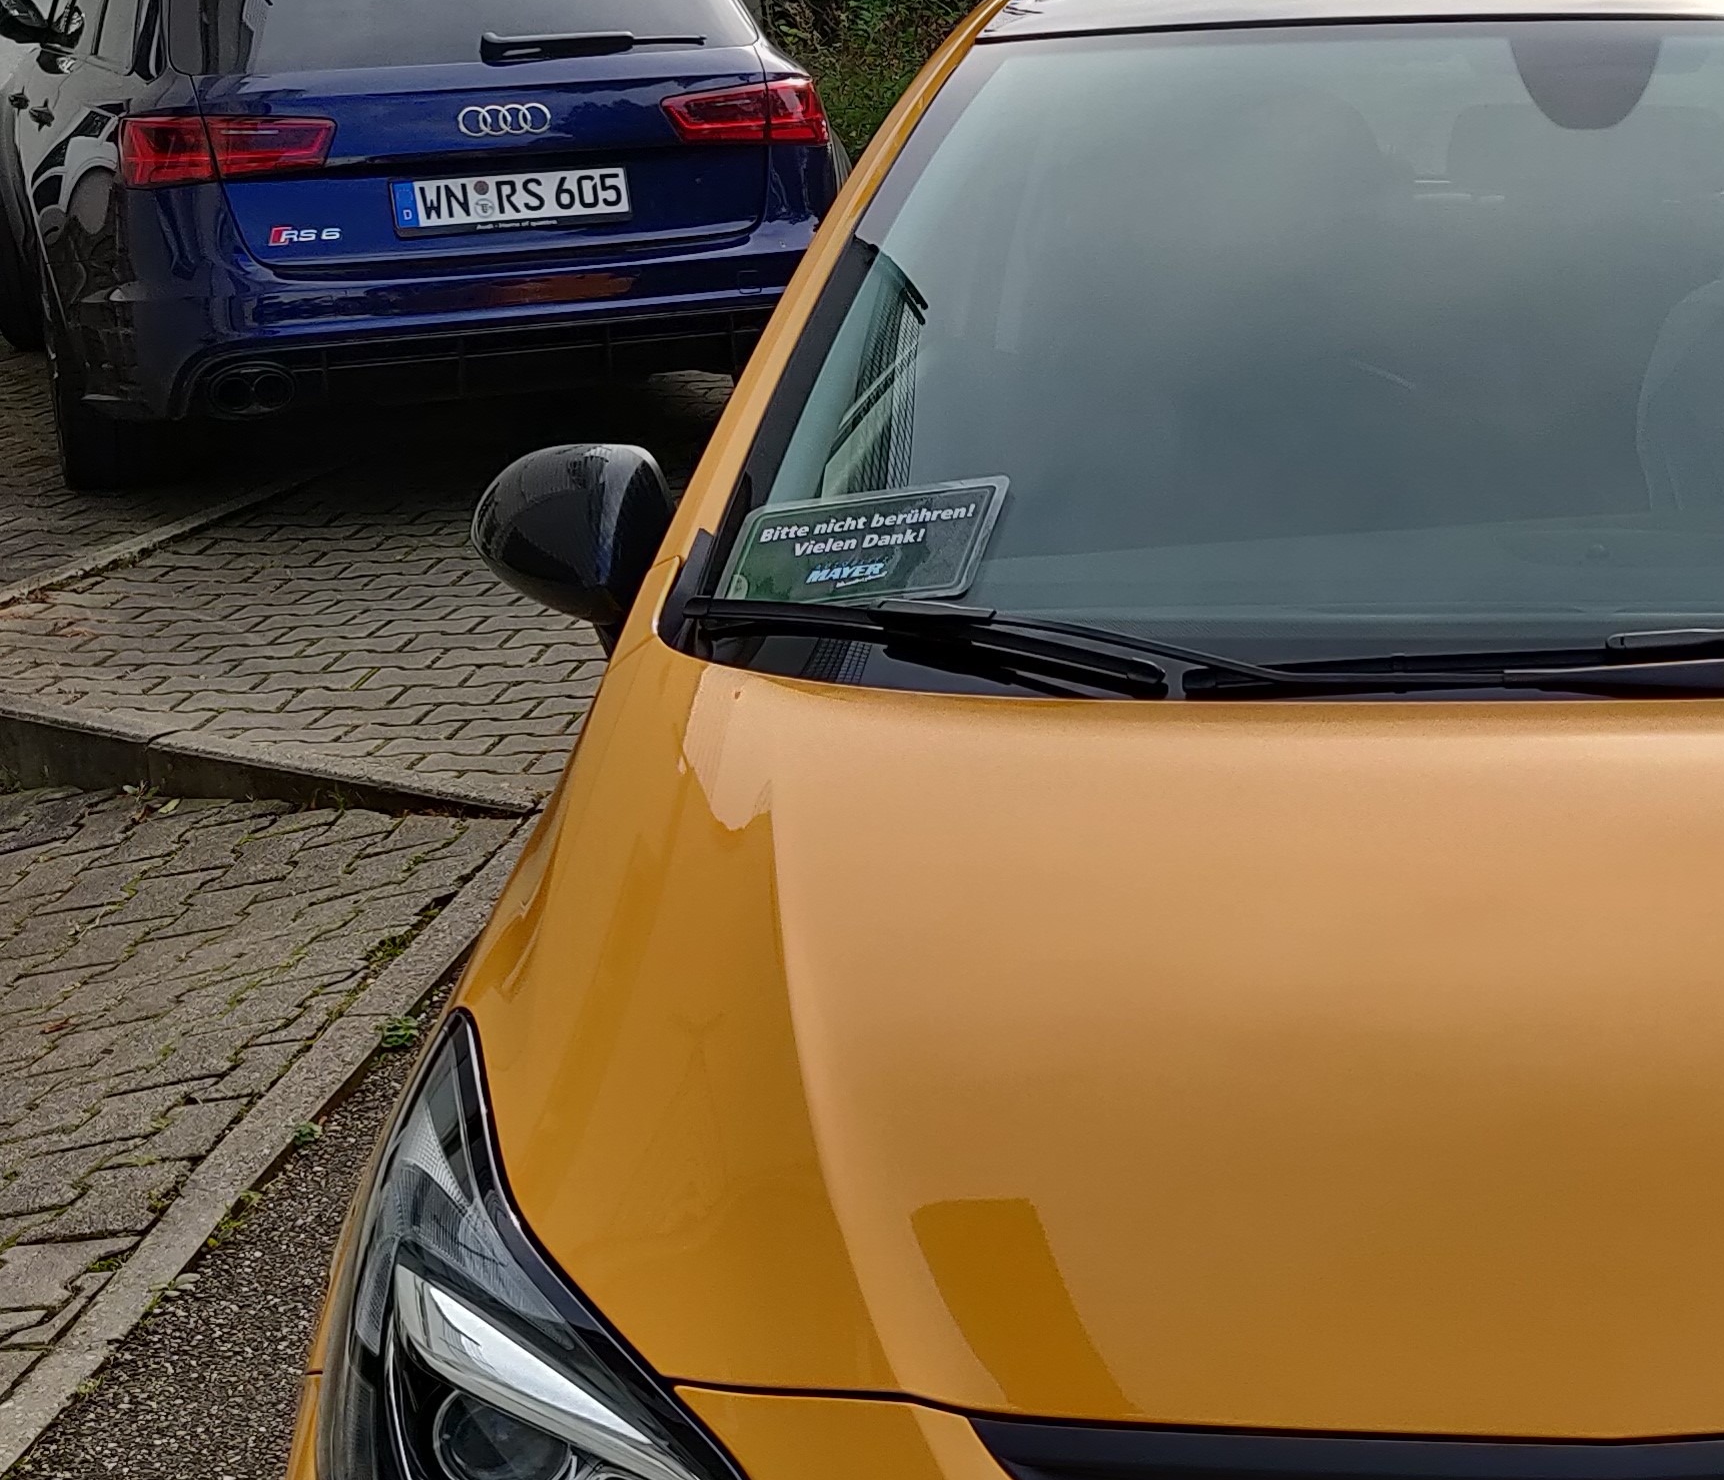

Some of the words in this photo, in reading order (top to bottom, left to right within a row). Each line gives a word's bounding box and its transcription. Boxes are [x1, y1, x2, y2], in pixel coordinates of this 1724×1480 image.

[419, 183, 471, 220] WN
[495, 178, 545, 215] RS
[555, 173, 622, 210] 605
[280, 229, 317, 242] RS
[321, 228, 341, 240] 6
[760, 525, 810, 543] Bitte
[813, 516, 867, 535] nicht
[870, 503, 976, 528] berühren!
[794, 538, 857, 556] Vielen
[862, 528, 926, 549] Dank!
[806, 562, 885, 583] MAYER
